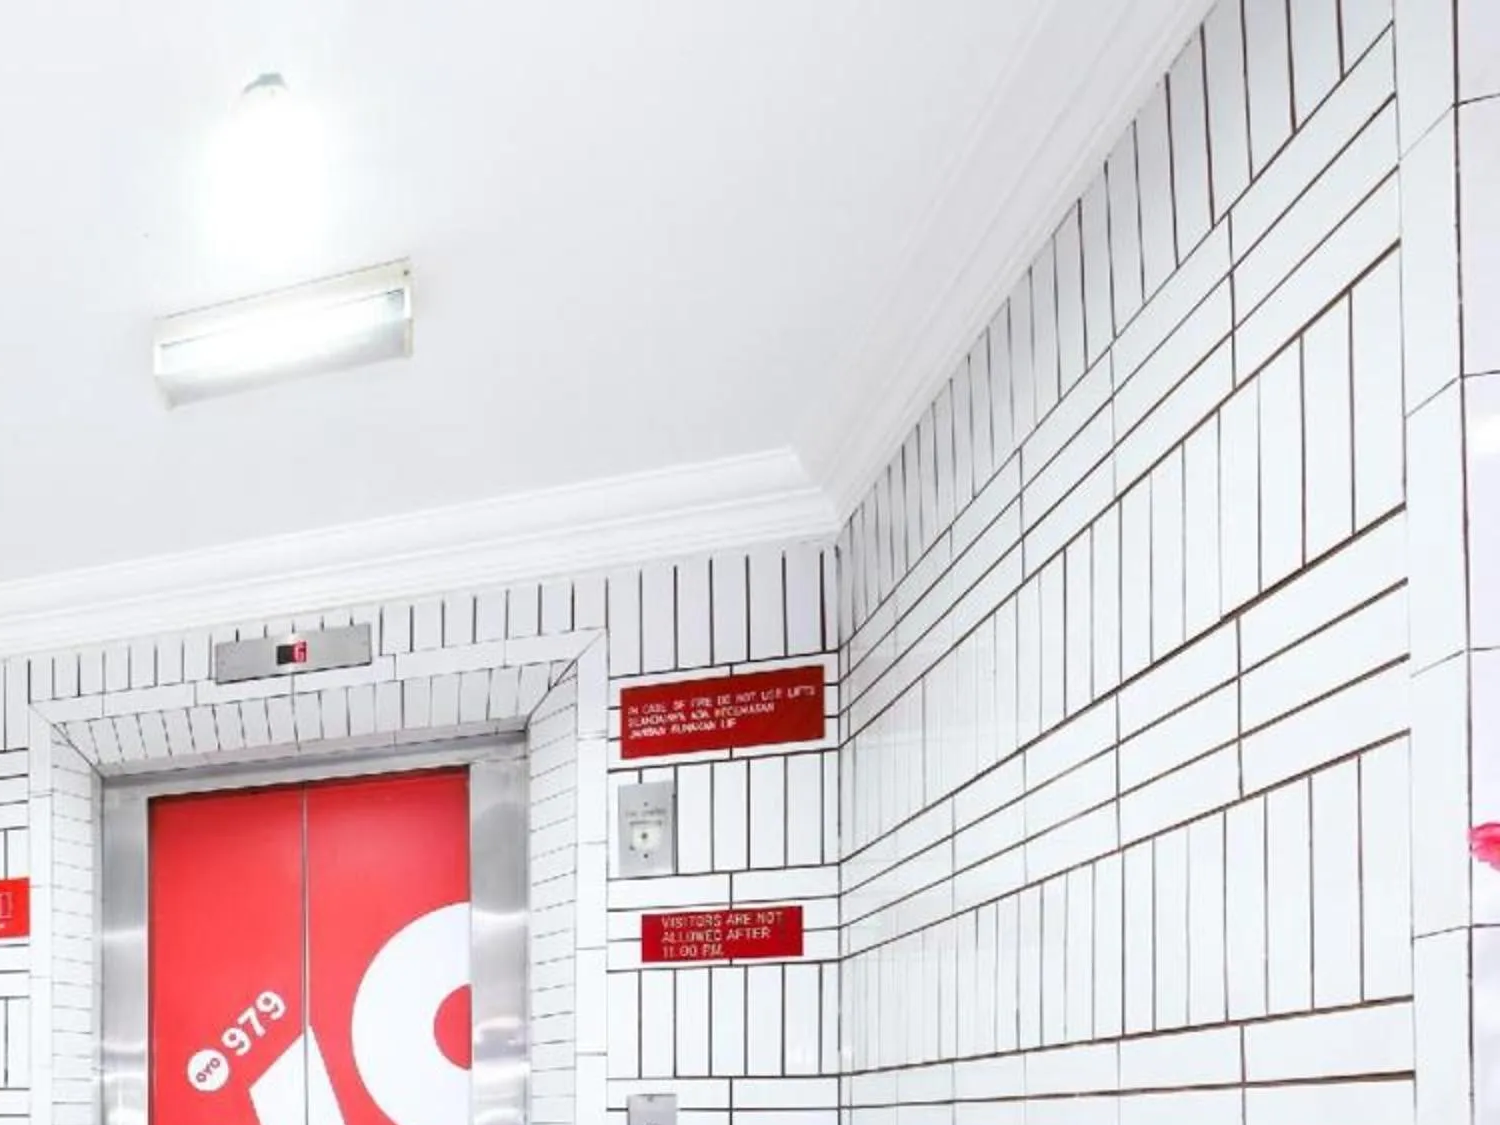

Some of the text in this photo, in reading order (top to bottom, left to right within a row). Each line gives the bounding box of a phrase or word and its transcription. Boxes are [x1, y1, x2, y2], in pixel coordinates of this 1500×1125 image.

[661, 911, 784, 929] VISITORS ARE NOT
[661, 926, 772, 944] ALLOWED AFTER
[195, 991, 286, 1083] OYO 979
